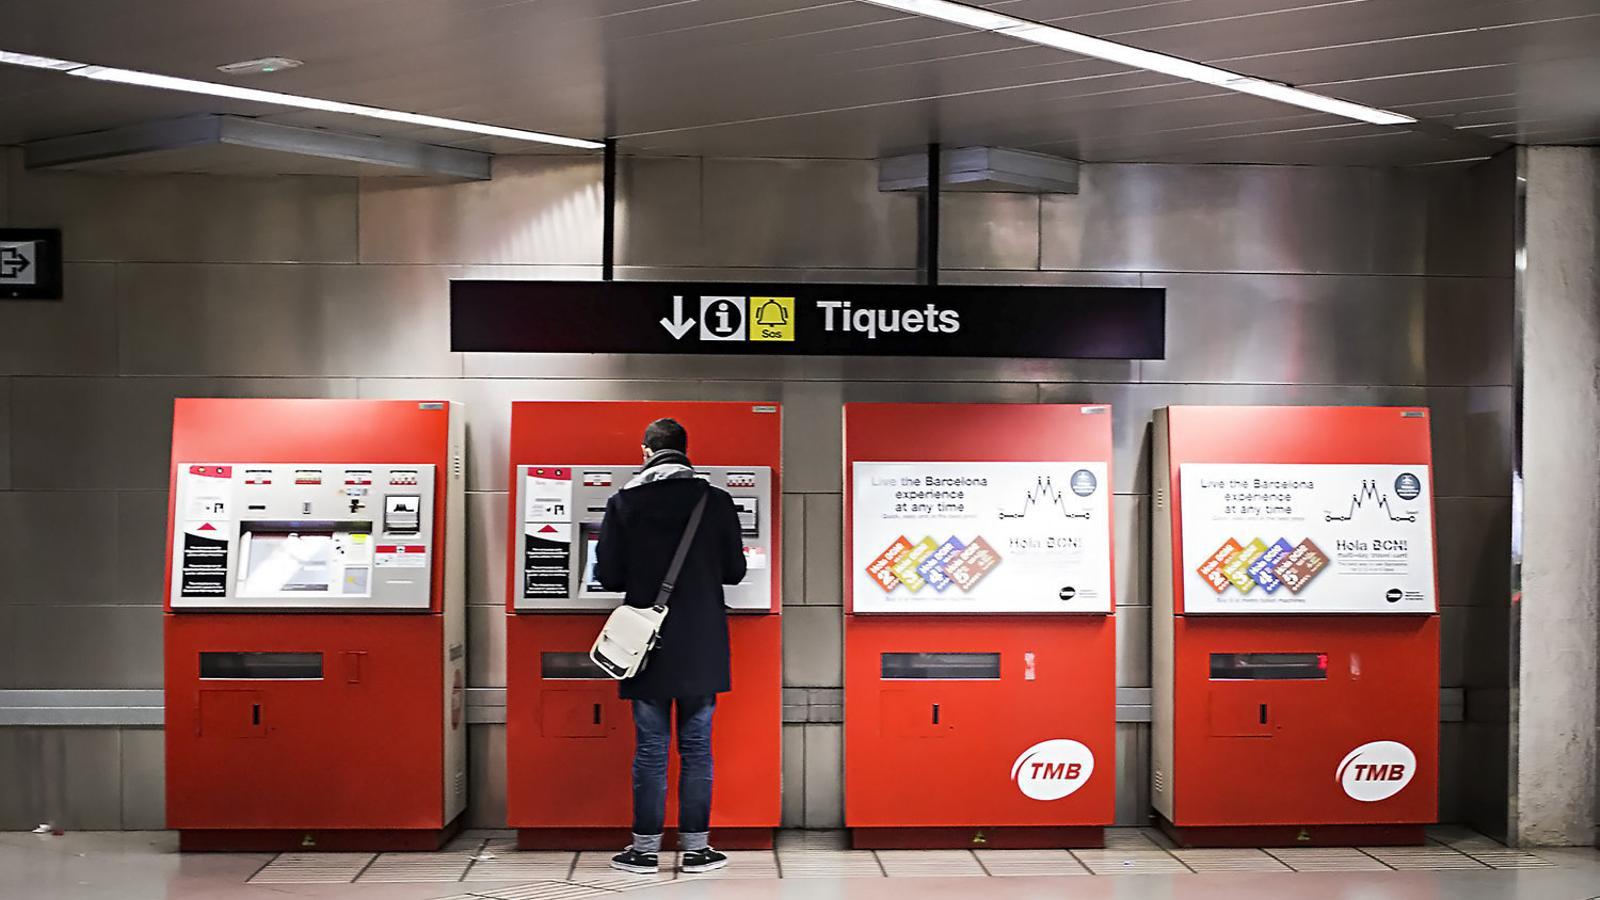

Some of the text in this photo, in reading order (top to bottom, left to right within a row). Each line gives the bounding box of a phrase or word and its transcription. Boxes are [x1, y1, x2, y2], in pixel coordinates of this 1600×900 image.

[816, 301, 960, 339] Tiquets
[901, 477, 921, 486] the
[925, 476, 988, 486] Barcelona
[1200, 479, 1314, 489] Live the Barcelona
[895, 490, 964, 501] experience
[1225, 493, 1291, 502] experience
[895, 503, 964, 514] at any time
[1225, 505, 1292, 516] at any time
[1336, 539, 1408, 551] Hola BCN!
[1031, 763, 1082, 780] TMB
[1354, 764, 1406, 781] TMB
